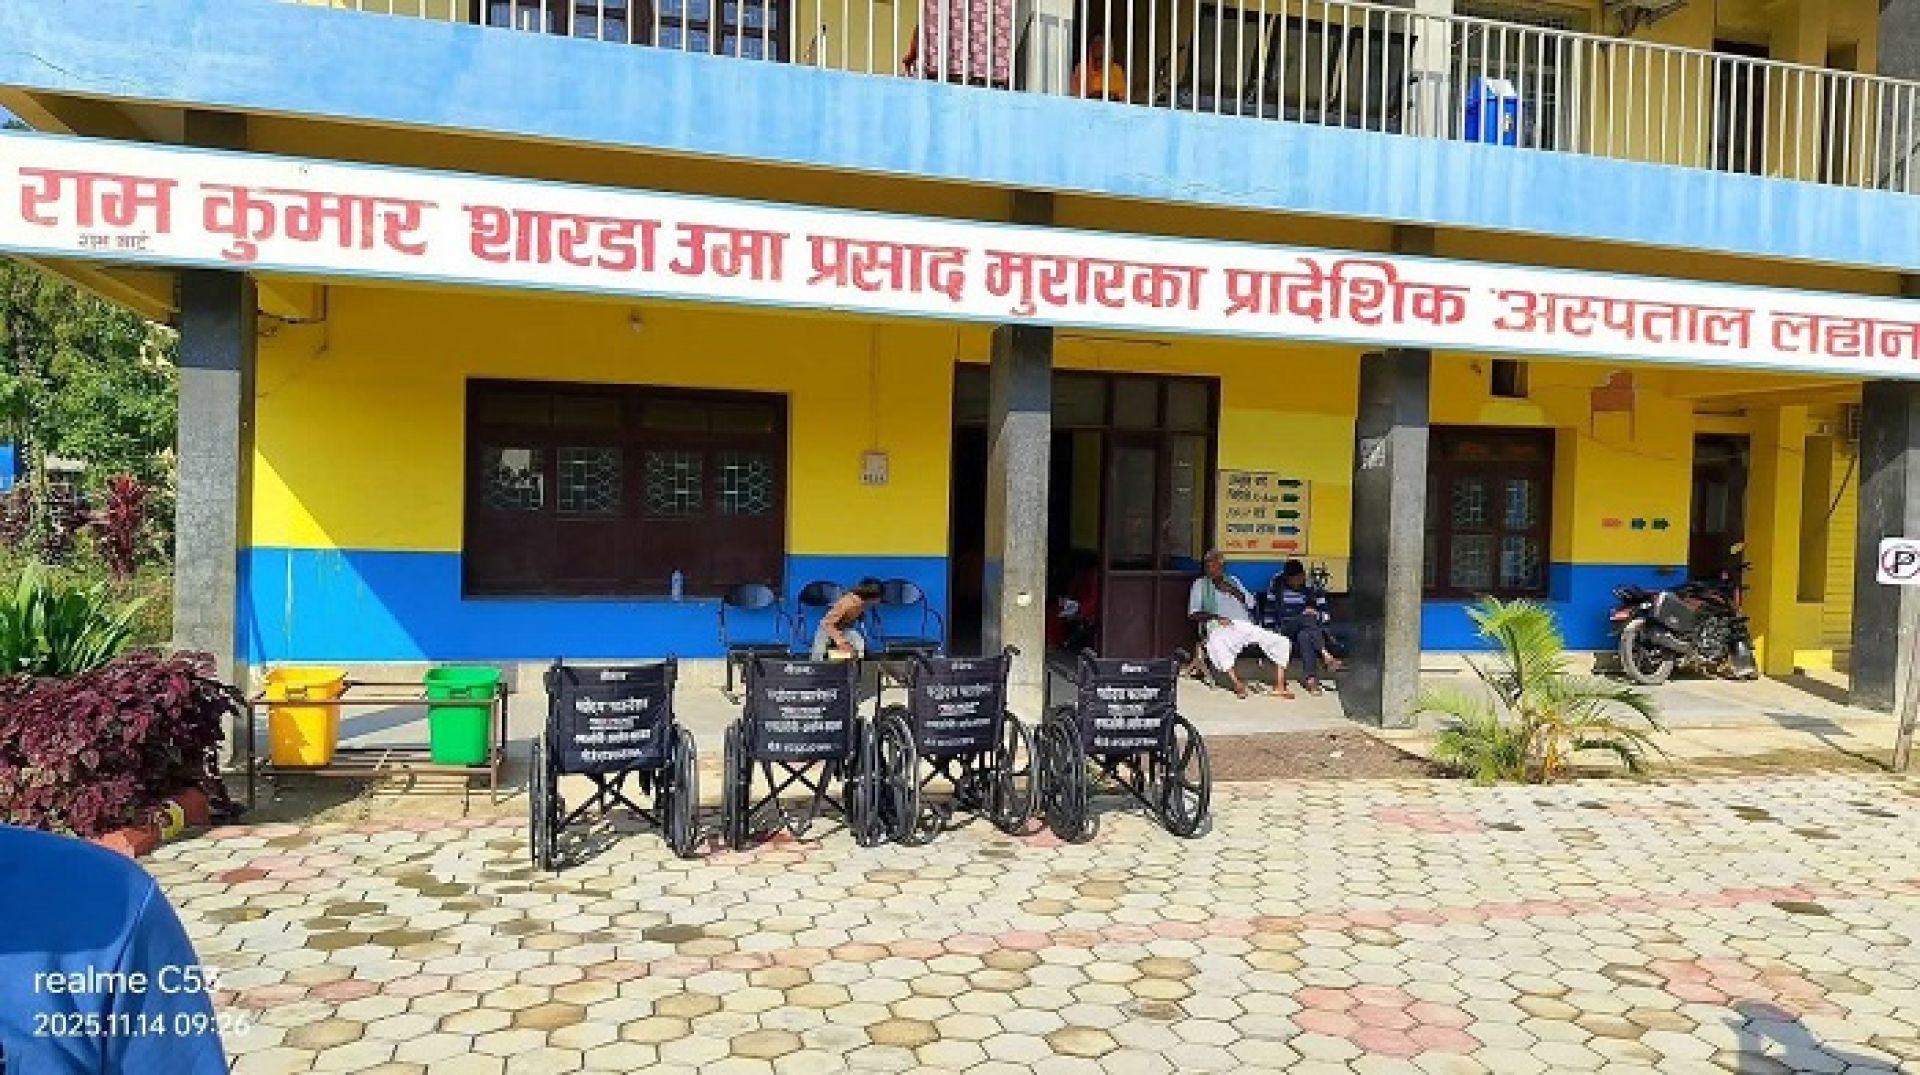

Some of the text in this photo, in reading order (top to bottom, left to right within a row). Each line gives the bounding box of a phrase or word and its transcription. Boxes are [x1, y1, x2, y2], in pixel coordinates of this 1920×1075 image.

[18, 167, 178, 233] राम
[200, 182, 438, 261] कुमार
[462, 204, 661, 272] शारडा
[668, 222, 790, 281] उमा
[806, 234, 969, 303] प्रसाद
[985, 249, 1208, 317] मुरारका
[1224, 258, 1470, 326] प्रादेशिक
[1492, 288, 1756, 348] अस्पताल
[1895, 551, 1915, 573] P
